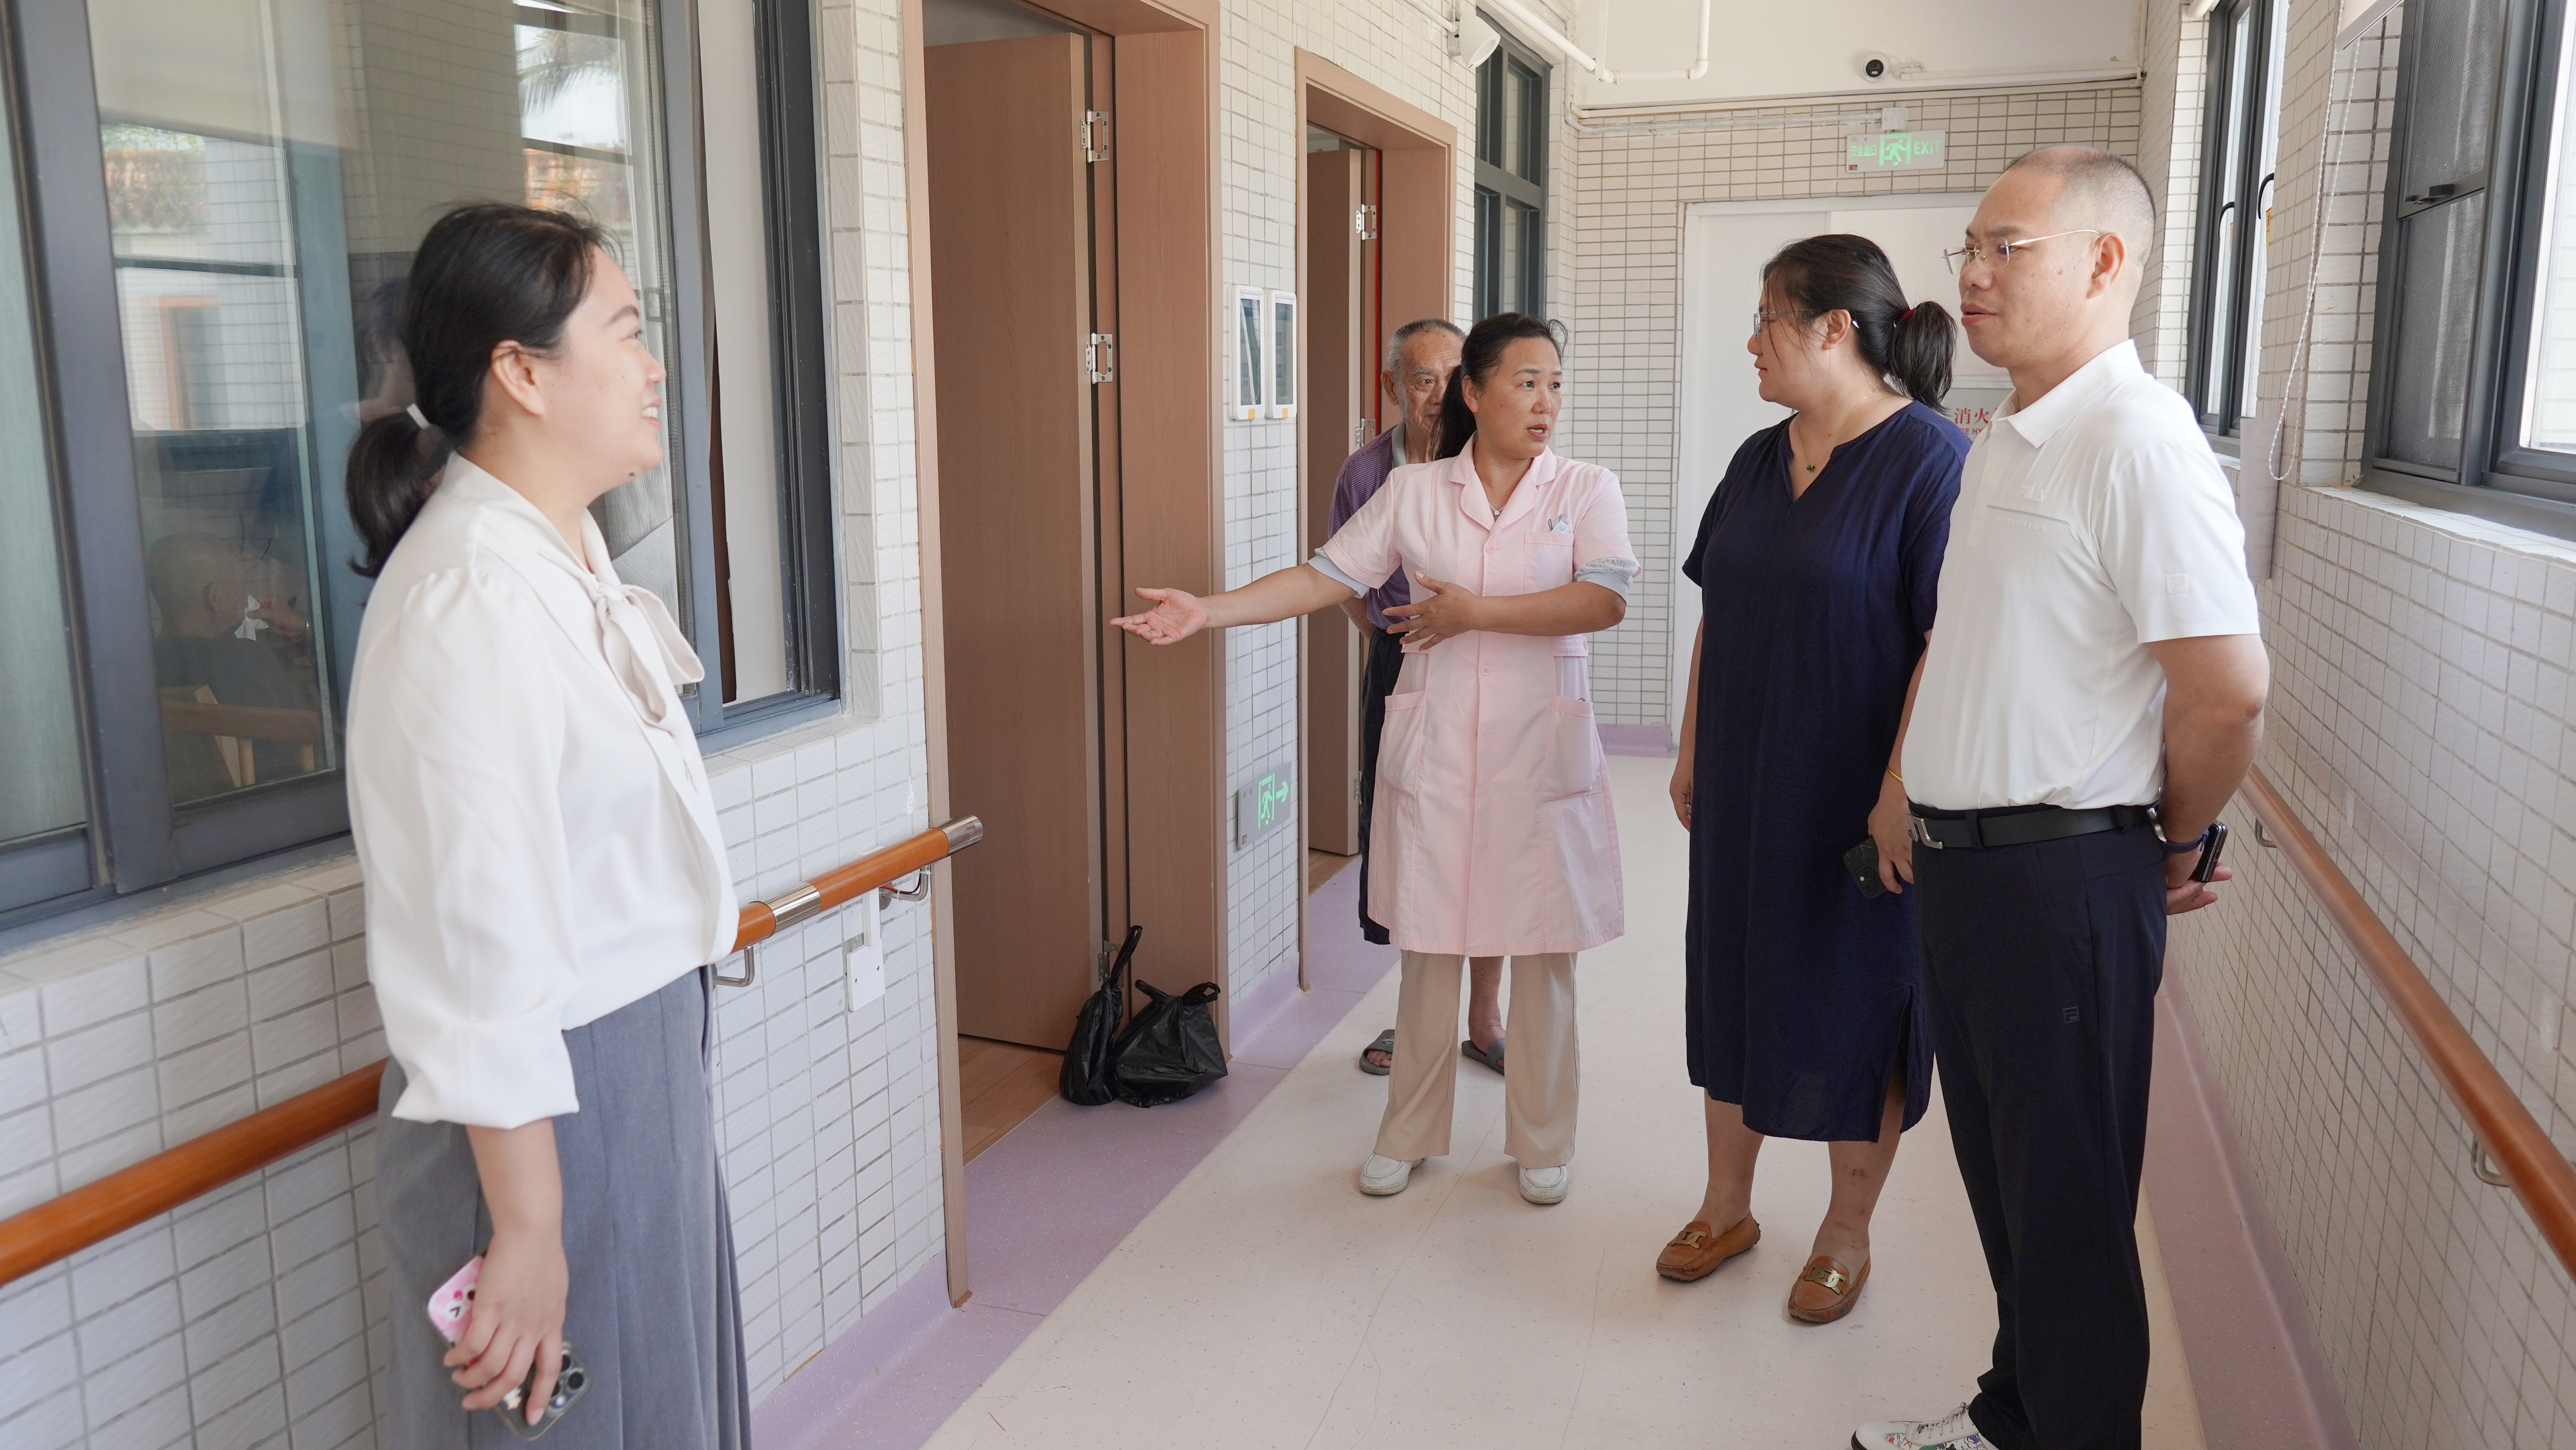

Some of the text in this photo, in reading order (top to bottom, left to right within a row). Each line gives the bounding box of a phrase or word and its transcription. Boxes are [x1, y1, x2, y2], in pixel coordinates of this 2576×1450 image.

[1850, 144, 1877, 157] 安全出口
[1913, 140, 1941, 155] EXIT
[1955, 408, 1997, 425] 消火
[1997, 516, 2046, 532] ATHLETICS
